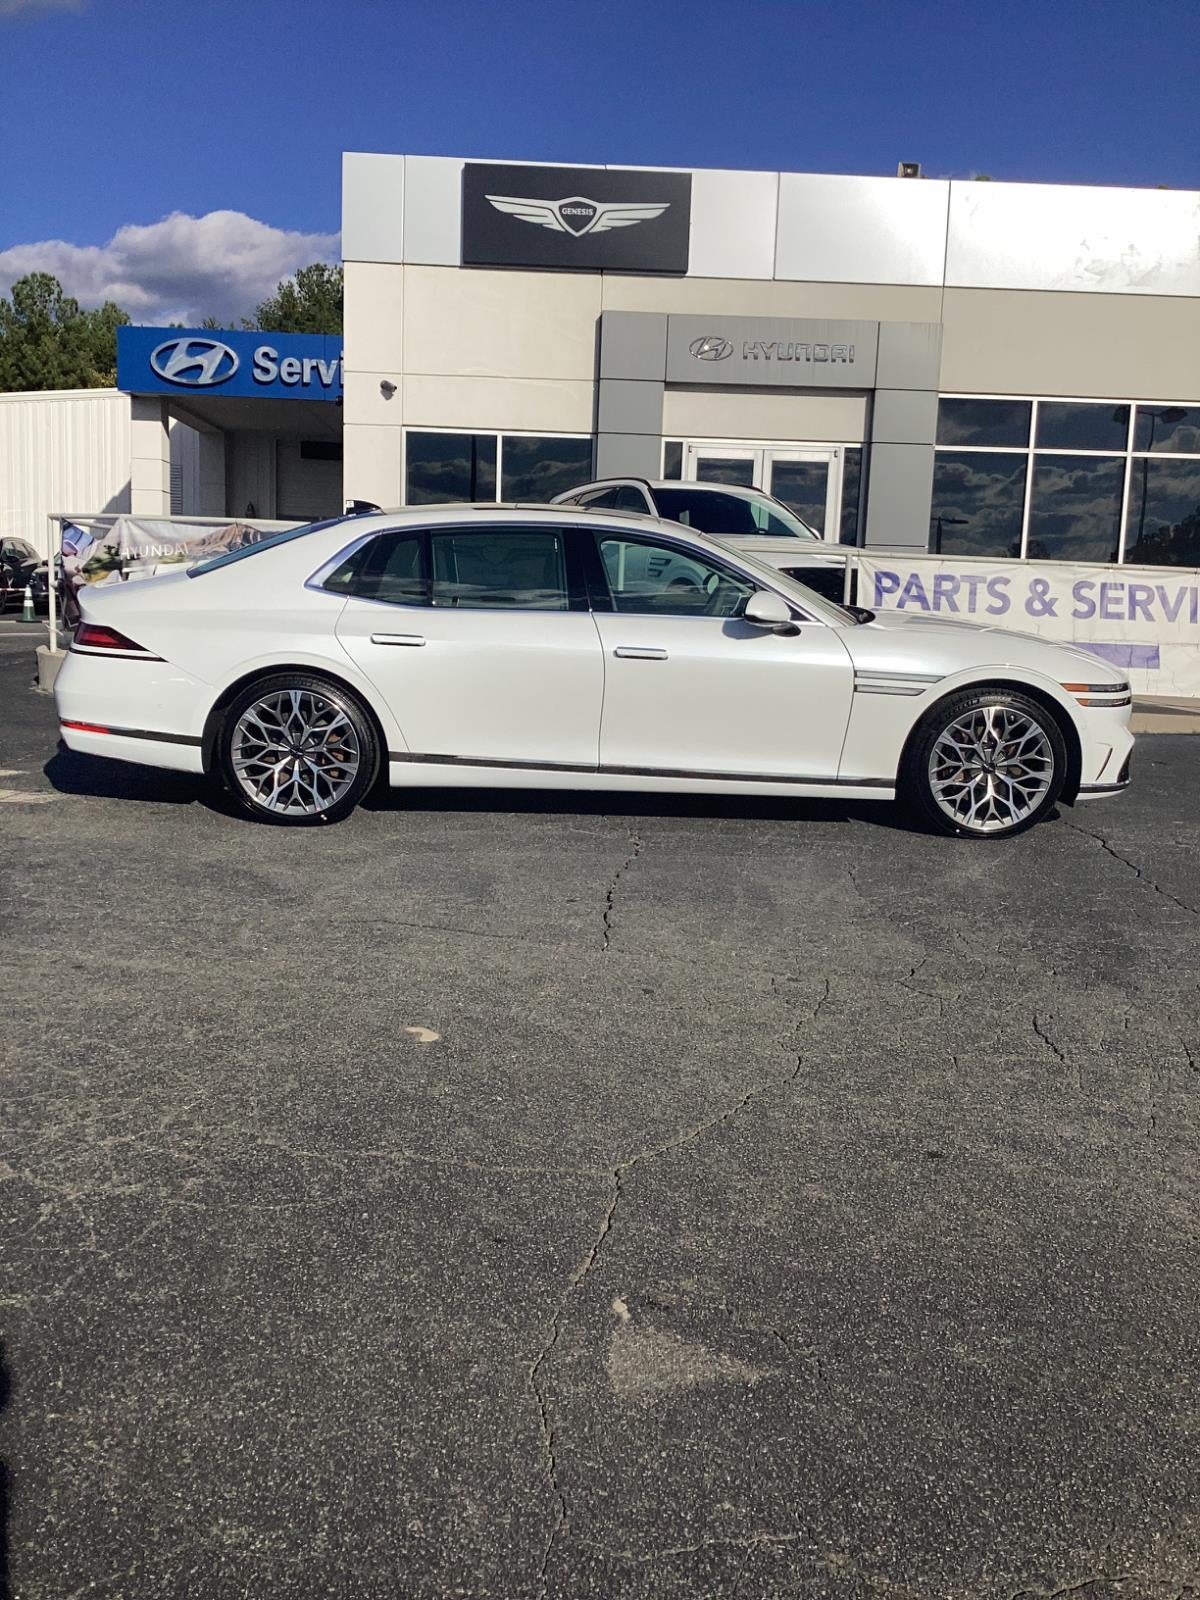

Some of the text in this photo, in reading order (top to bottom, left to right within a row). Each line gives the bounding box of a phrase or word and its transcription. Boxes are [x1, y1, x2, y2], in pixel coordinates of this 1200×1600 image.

[561, 207, 594, 216] GENESIS
[742, 341, 855, 363] HYUNDAI
[121, 541, 189, 560] HYUNDAI
[874, 570, 1199, 625] PARTS & SERVI
